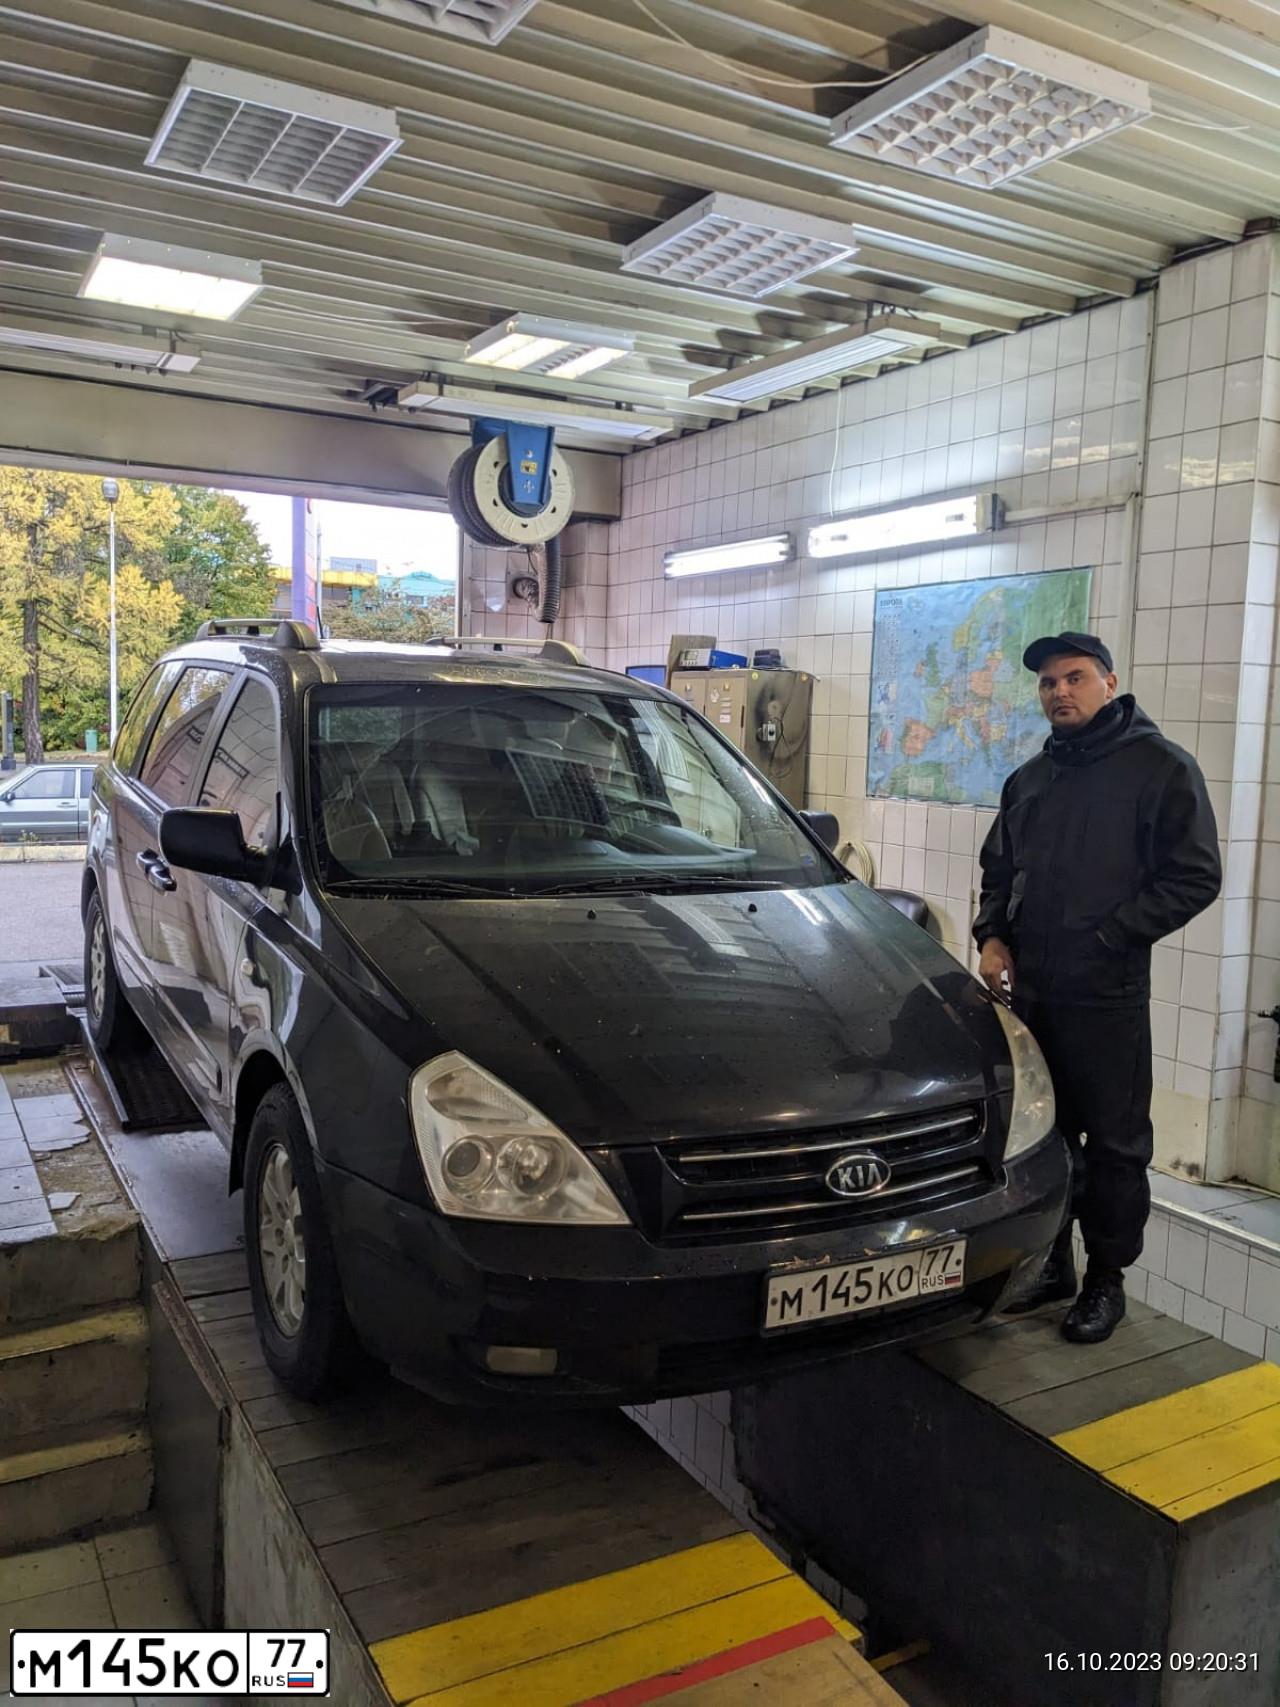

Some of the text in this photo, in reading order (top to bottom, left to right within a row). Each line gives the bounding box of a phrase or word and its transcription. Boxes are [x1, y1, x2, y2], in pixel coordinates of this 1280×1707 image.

[838, 1163, 882, 1190] KIA
[780, 1245, 955, 1319] М145КО 77
[921, 1274, 944, 1288] RUS
